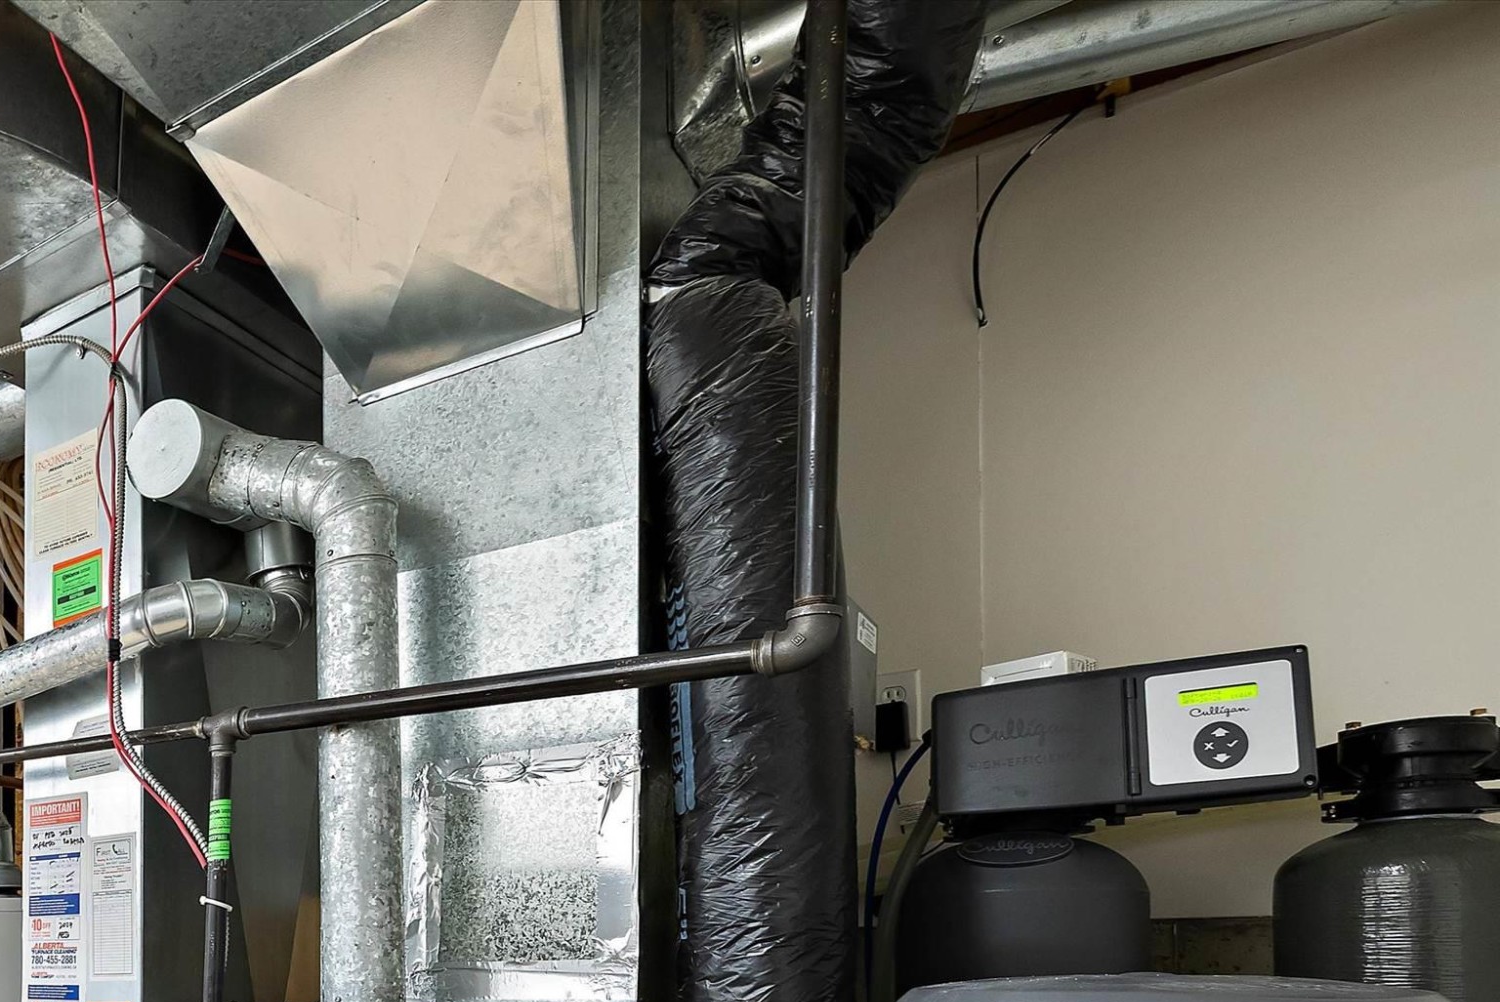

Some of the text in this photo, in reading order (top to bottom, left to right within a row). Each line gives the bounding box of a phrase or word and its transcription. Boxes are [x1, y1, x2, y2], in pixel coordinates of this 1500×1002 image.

[1188, 706, 1251, 718] Culligan
[31, 801, 80, 817] IMPORTANT!
[963, 839, 1072, 855] Culligan
[32, 942, 65, 950] ALBERTA
[31, 955, 77, 965] 780-455-2881
